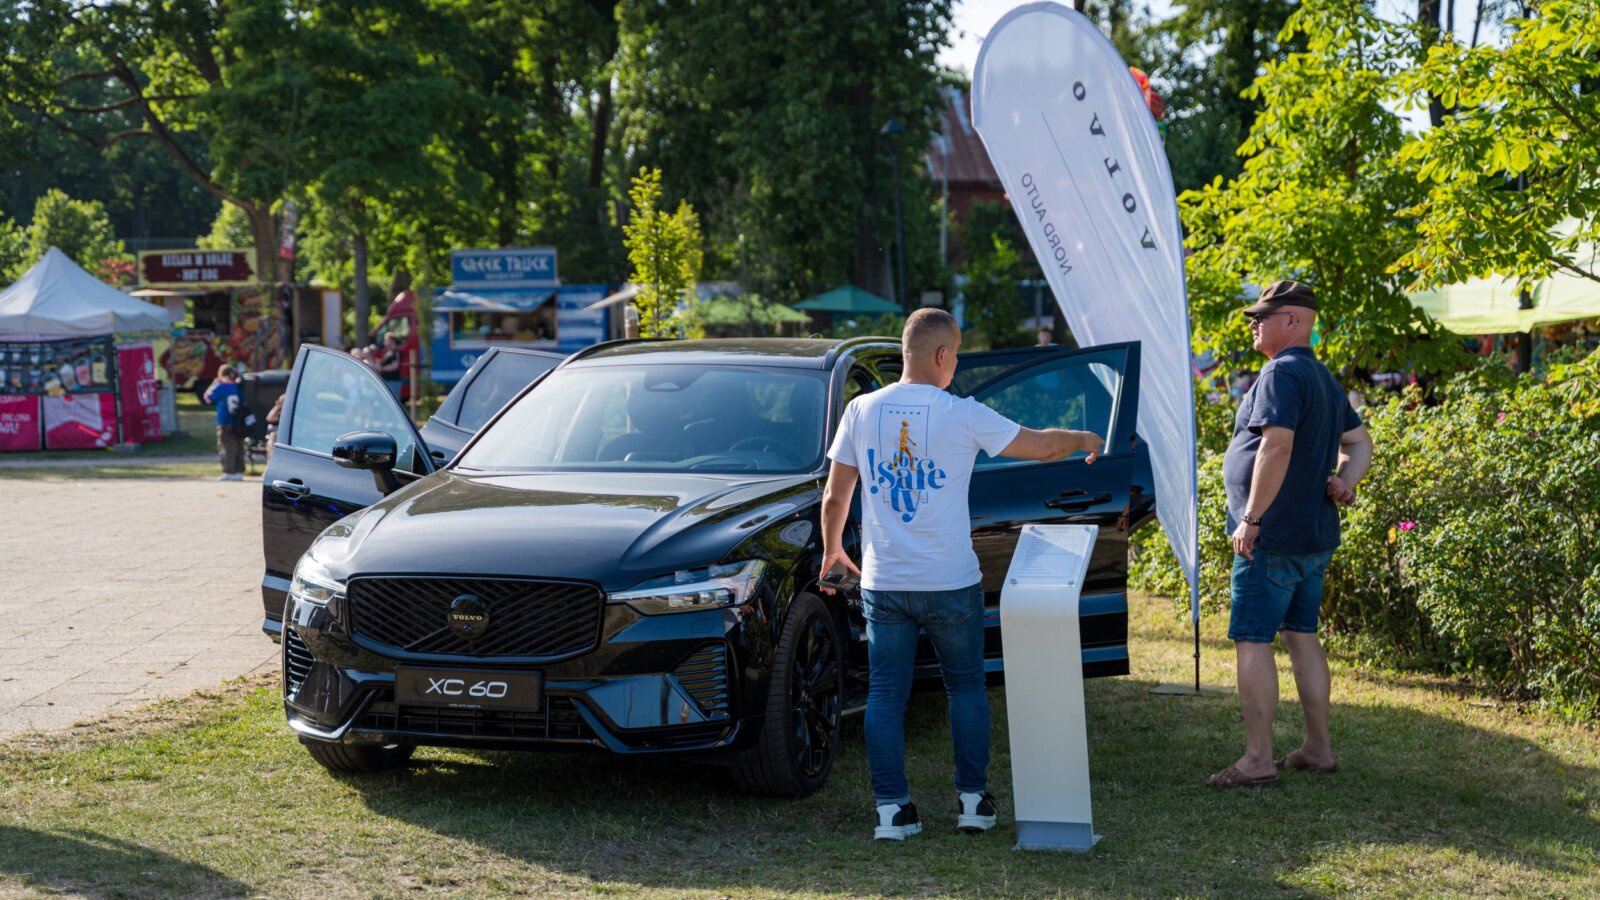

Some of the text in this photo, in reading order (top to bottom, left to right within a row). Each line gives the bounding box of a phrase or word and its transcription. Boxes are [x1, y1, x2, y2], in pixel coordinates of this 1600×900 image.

[461, 256, 548, 272] GREEK TRUCK
[425, 677, 508, 697] XC 60
